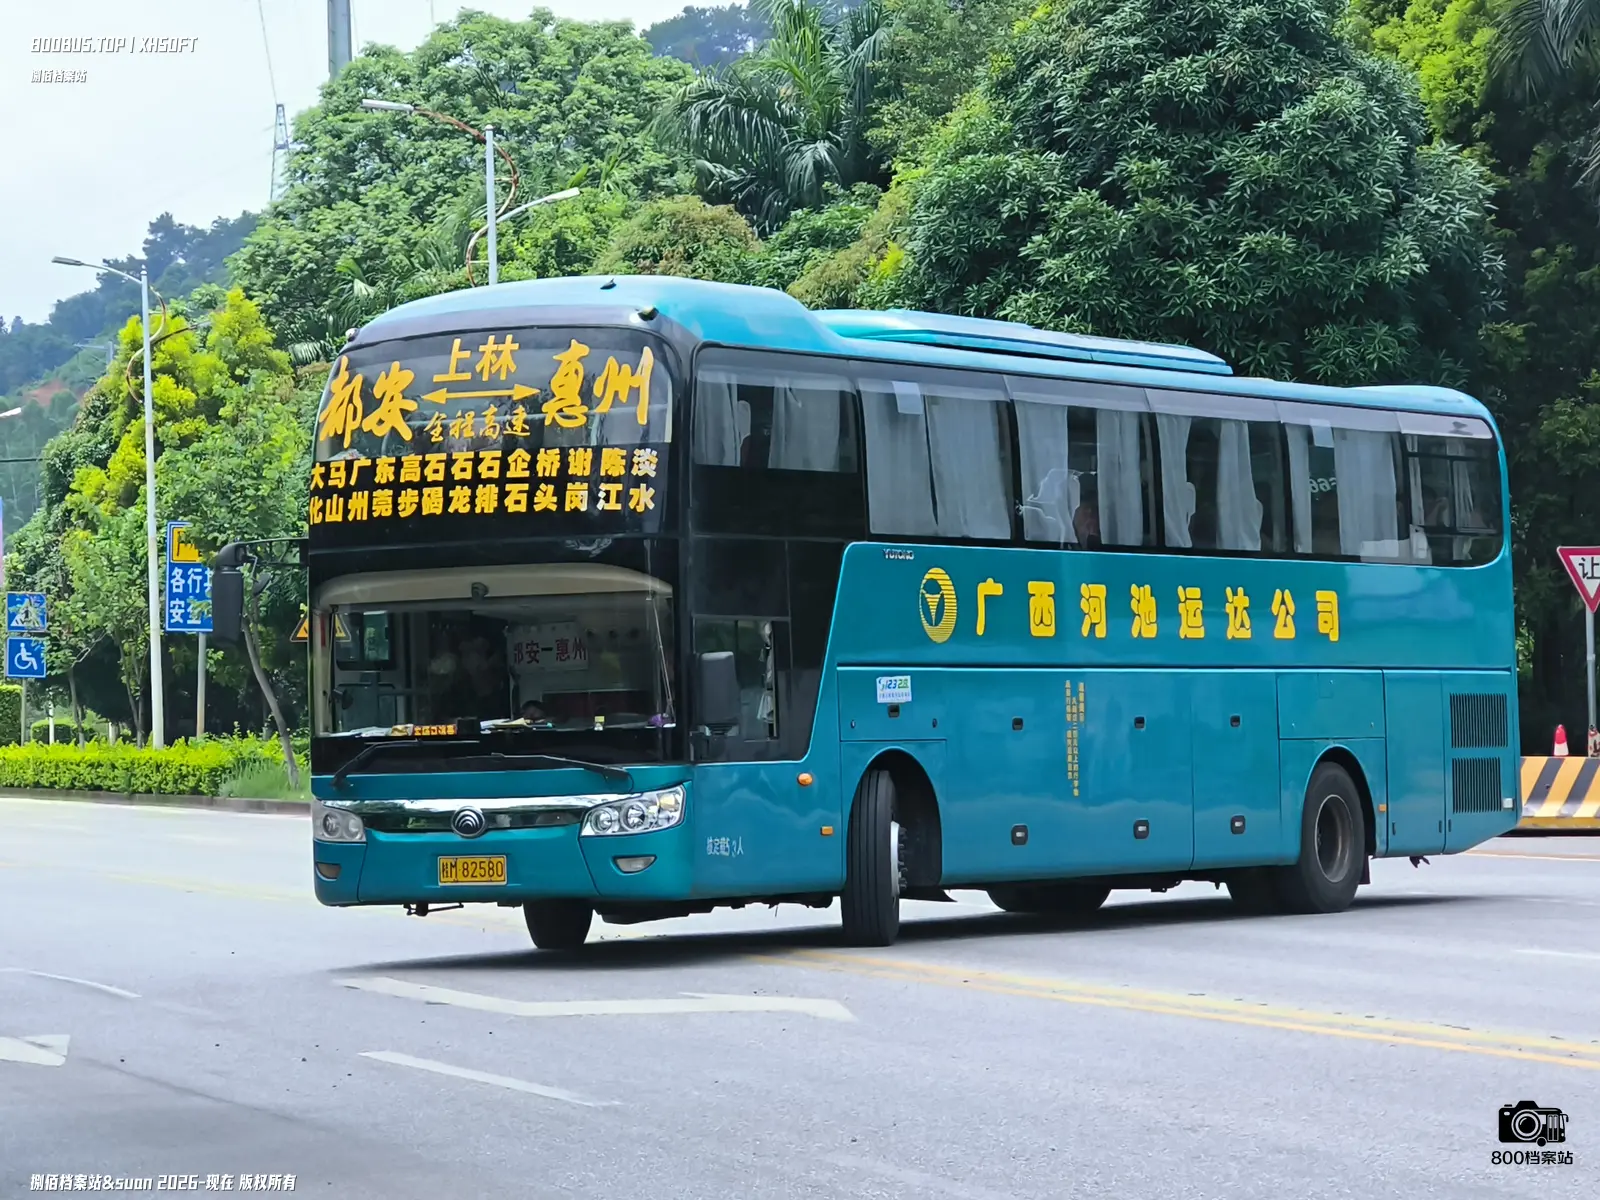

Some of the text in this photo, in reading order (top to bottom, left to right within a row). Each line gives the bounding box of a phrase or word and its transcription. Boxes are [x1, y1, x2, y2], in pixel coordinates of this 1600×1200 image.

[433, 334, 521, 383] 上林
[318, 338, 655, 449] 都安 惠州
[423, 403, 531, 443] 全程高速
[1578, 556, 1600, 580] 让
[974, 577, 1340, 642] 广西河池运达公司
